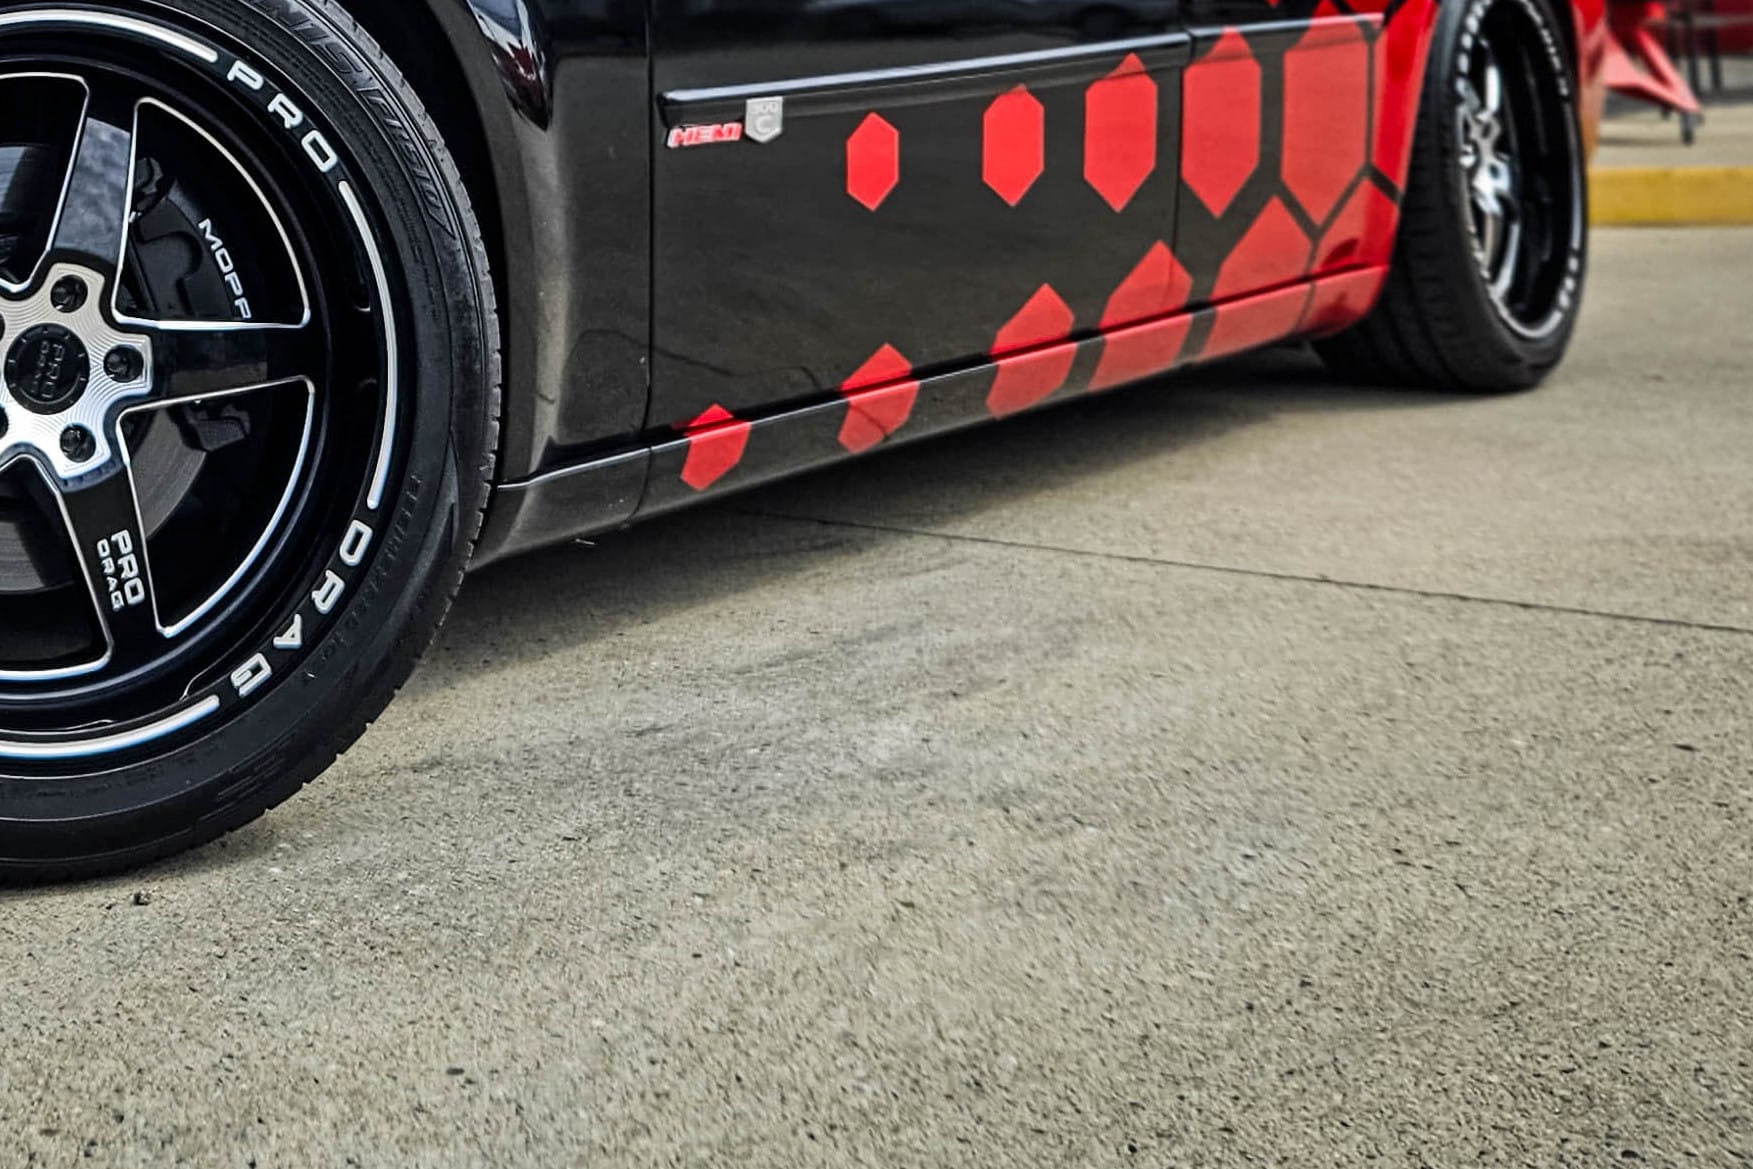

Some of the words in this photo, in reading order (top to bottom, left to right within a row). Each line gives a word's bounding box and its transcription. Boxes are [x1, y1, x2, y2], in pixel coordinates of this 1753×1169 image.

[226, 60, 338, 173] PRO
[97, 538, 125, 612] DRAG
[110, 529, 145, 605] PRO
[230, 519, 372, 698] DRAG
